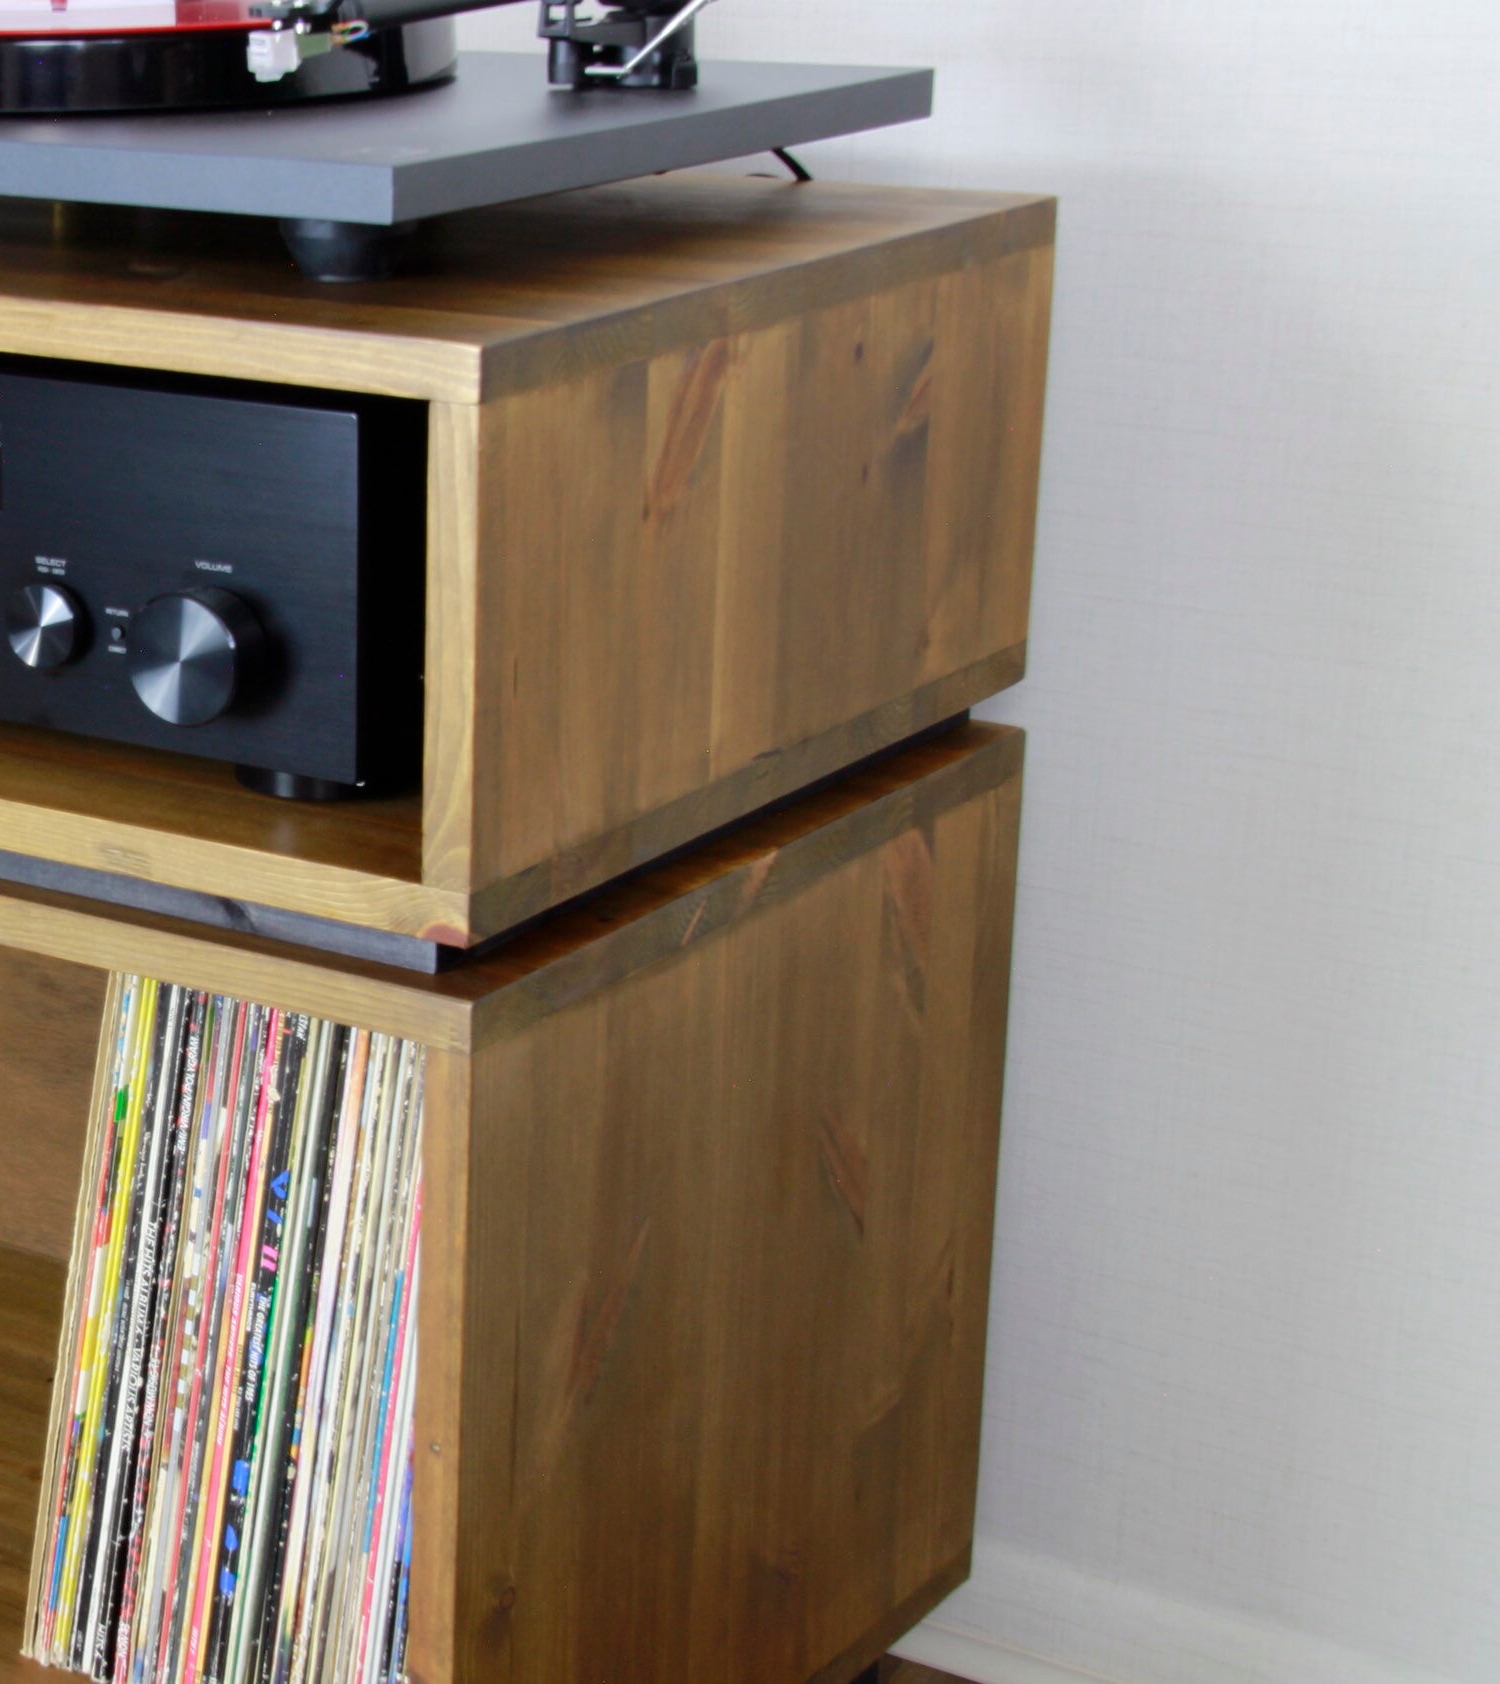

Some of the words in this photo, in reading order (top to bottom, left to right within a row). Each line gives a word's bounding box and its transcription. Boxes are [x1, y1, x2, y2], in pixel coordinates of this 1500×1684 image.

[194, 560, 233, 574] VOLUME
[230, 1273, 244, 1314] VARIOUS
[255, 1296, 269, 1312] THE
[250, 1312, 266, 1351] GREATEST
[248, 1352, 261, 1369] HITS
[247, 1369, 257, 1381] OF
[244, 1382, 256, 1402] 1985
